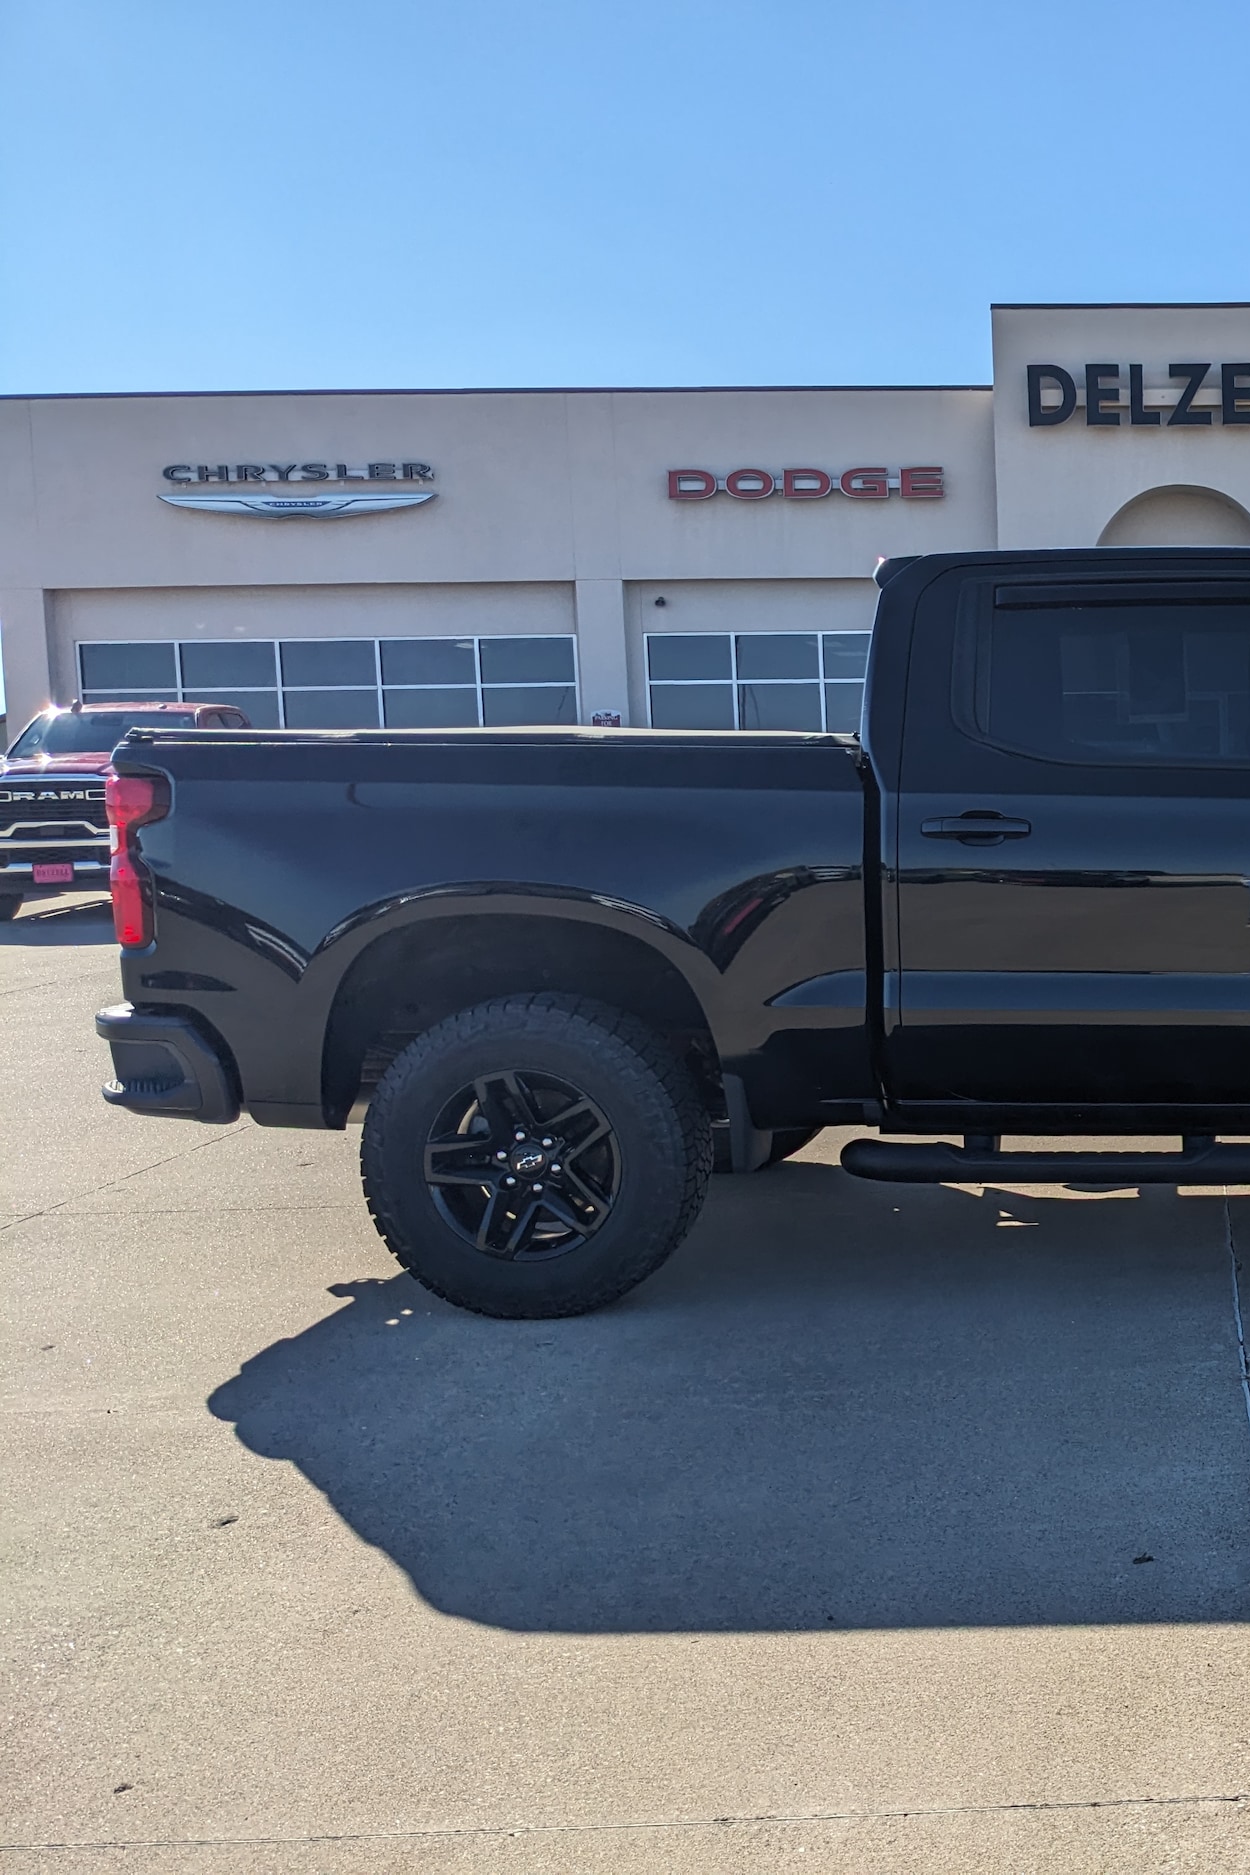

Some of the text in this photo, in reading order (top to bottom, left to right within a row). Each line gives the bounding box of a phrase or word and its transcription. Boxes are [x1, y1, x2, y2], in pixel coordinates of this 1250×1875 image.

[162, 463, 435, 482] CHRYSLER
[667, 467, 945, 499] DODGE
[12, 790, 85, 801] RAM
